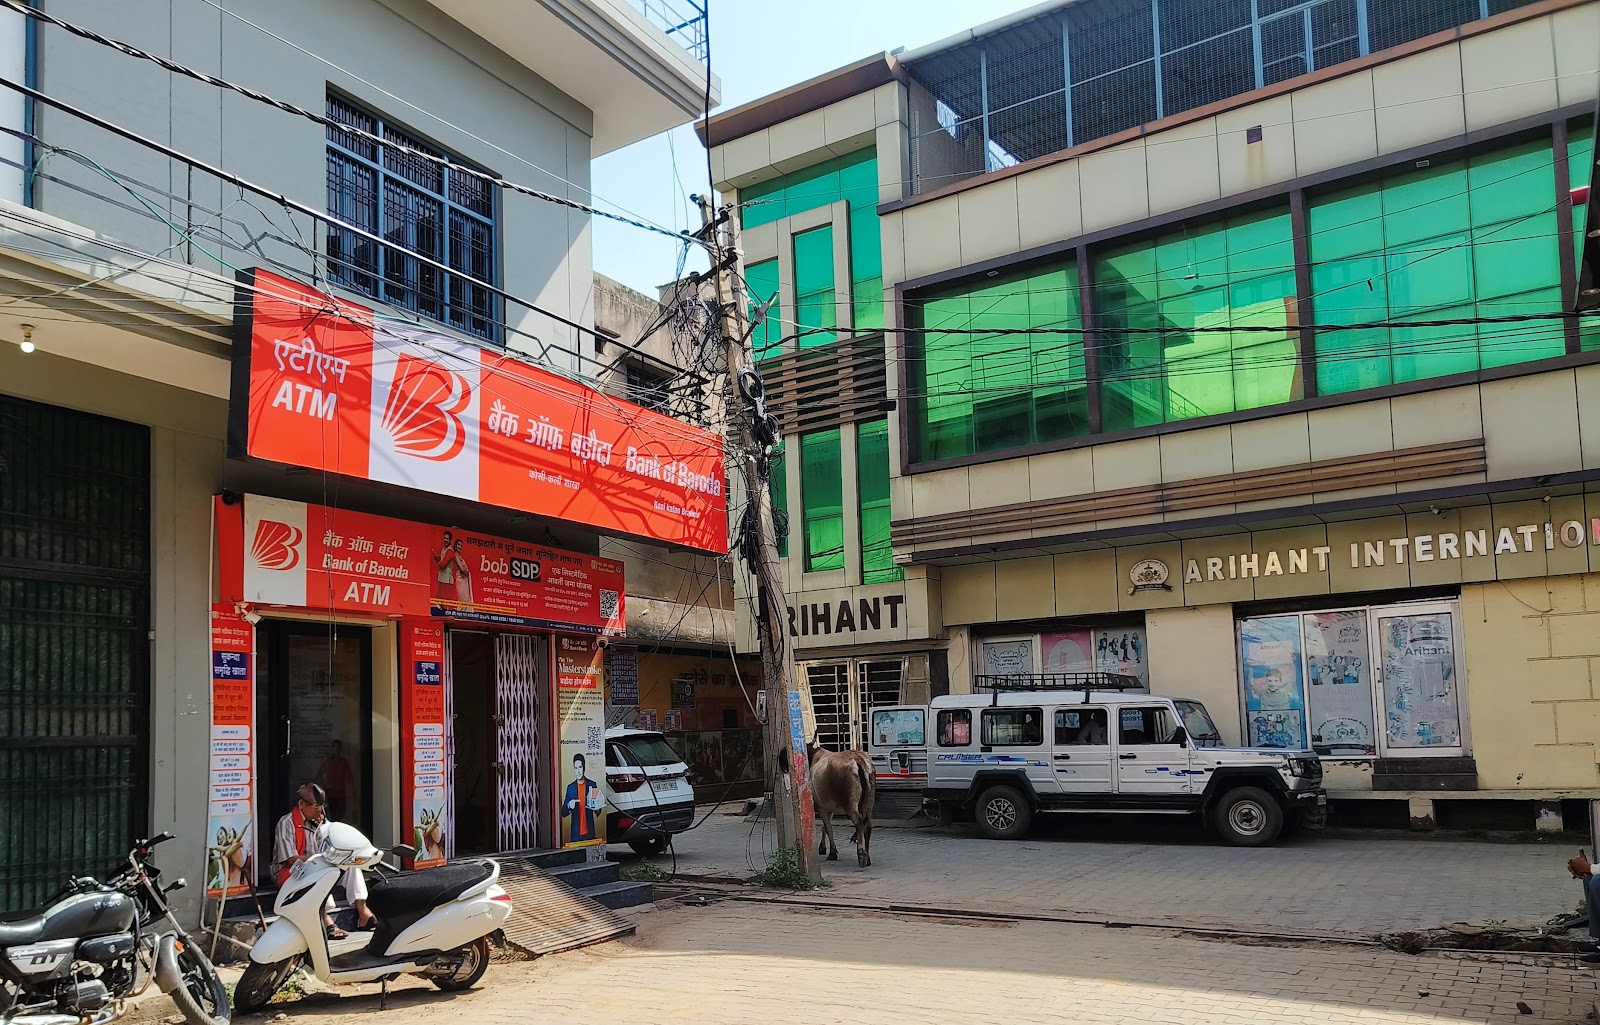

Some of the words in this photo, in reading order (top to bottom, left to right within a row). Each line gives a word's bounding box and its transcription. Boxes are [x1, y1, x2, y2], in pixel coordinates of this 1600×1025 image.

[274, 336, 350, 384] एटीएम
[272, 380, 337, 421] ATM
[488, 398, 520, 437] बैंक
[570, 428, 613, 467] बड़ौदा
[564, 478, 580, 490] शाखा
[625, 445, 661, 480] Bank
[663, 460, 677, 484] of
[678, 462, 721, 496] Baroda
[323, 529, 344, 548] बैंक
[378, 540, 409, 560] बड़ौदा
[497, 540, 503, 550] से
[322, 553, 354, 571] Bank
[355, 559, 368, 573] of
[368, 560, 409, 579] Baroda
[480, 554, 509, 575] bob
[511, 560, 539, 579] SDP
[1185, 546, 1331, 584] ARIHANT
[343, 581, 391, 606] ATM
[772, 595, 903, 639] RIHANT
[559, 663, 601, 675] Masterstroke
[937, 753, 983, 761] CRUISER
